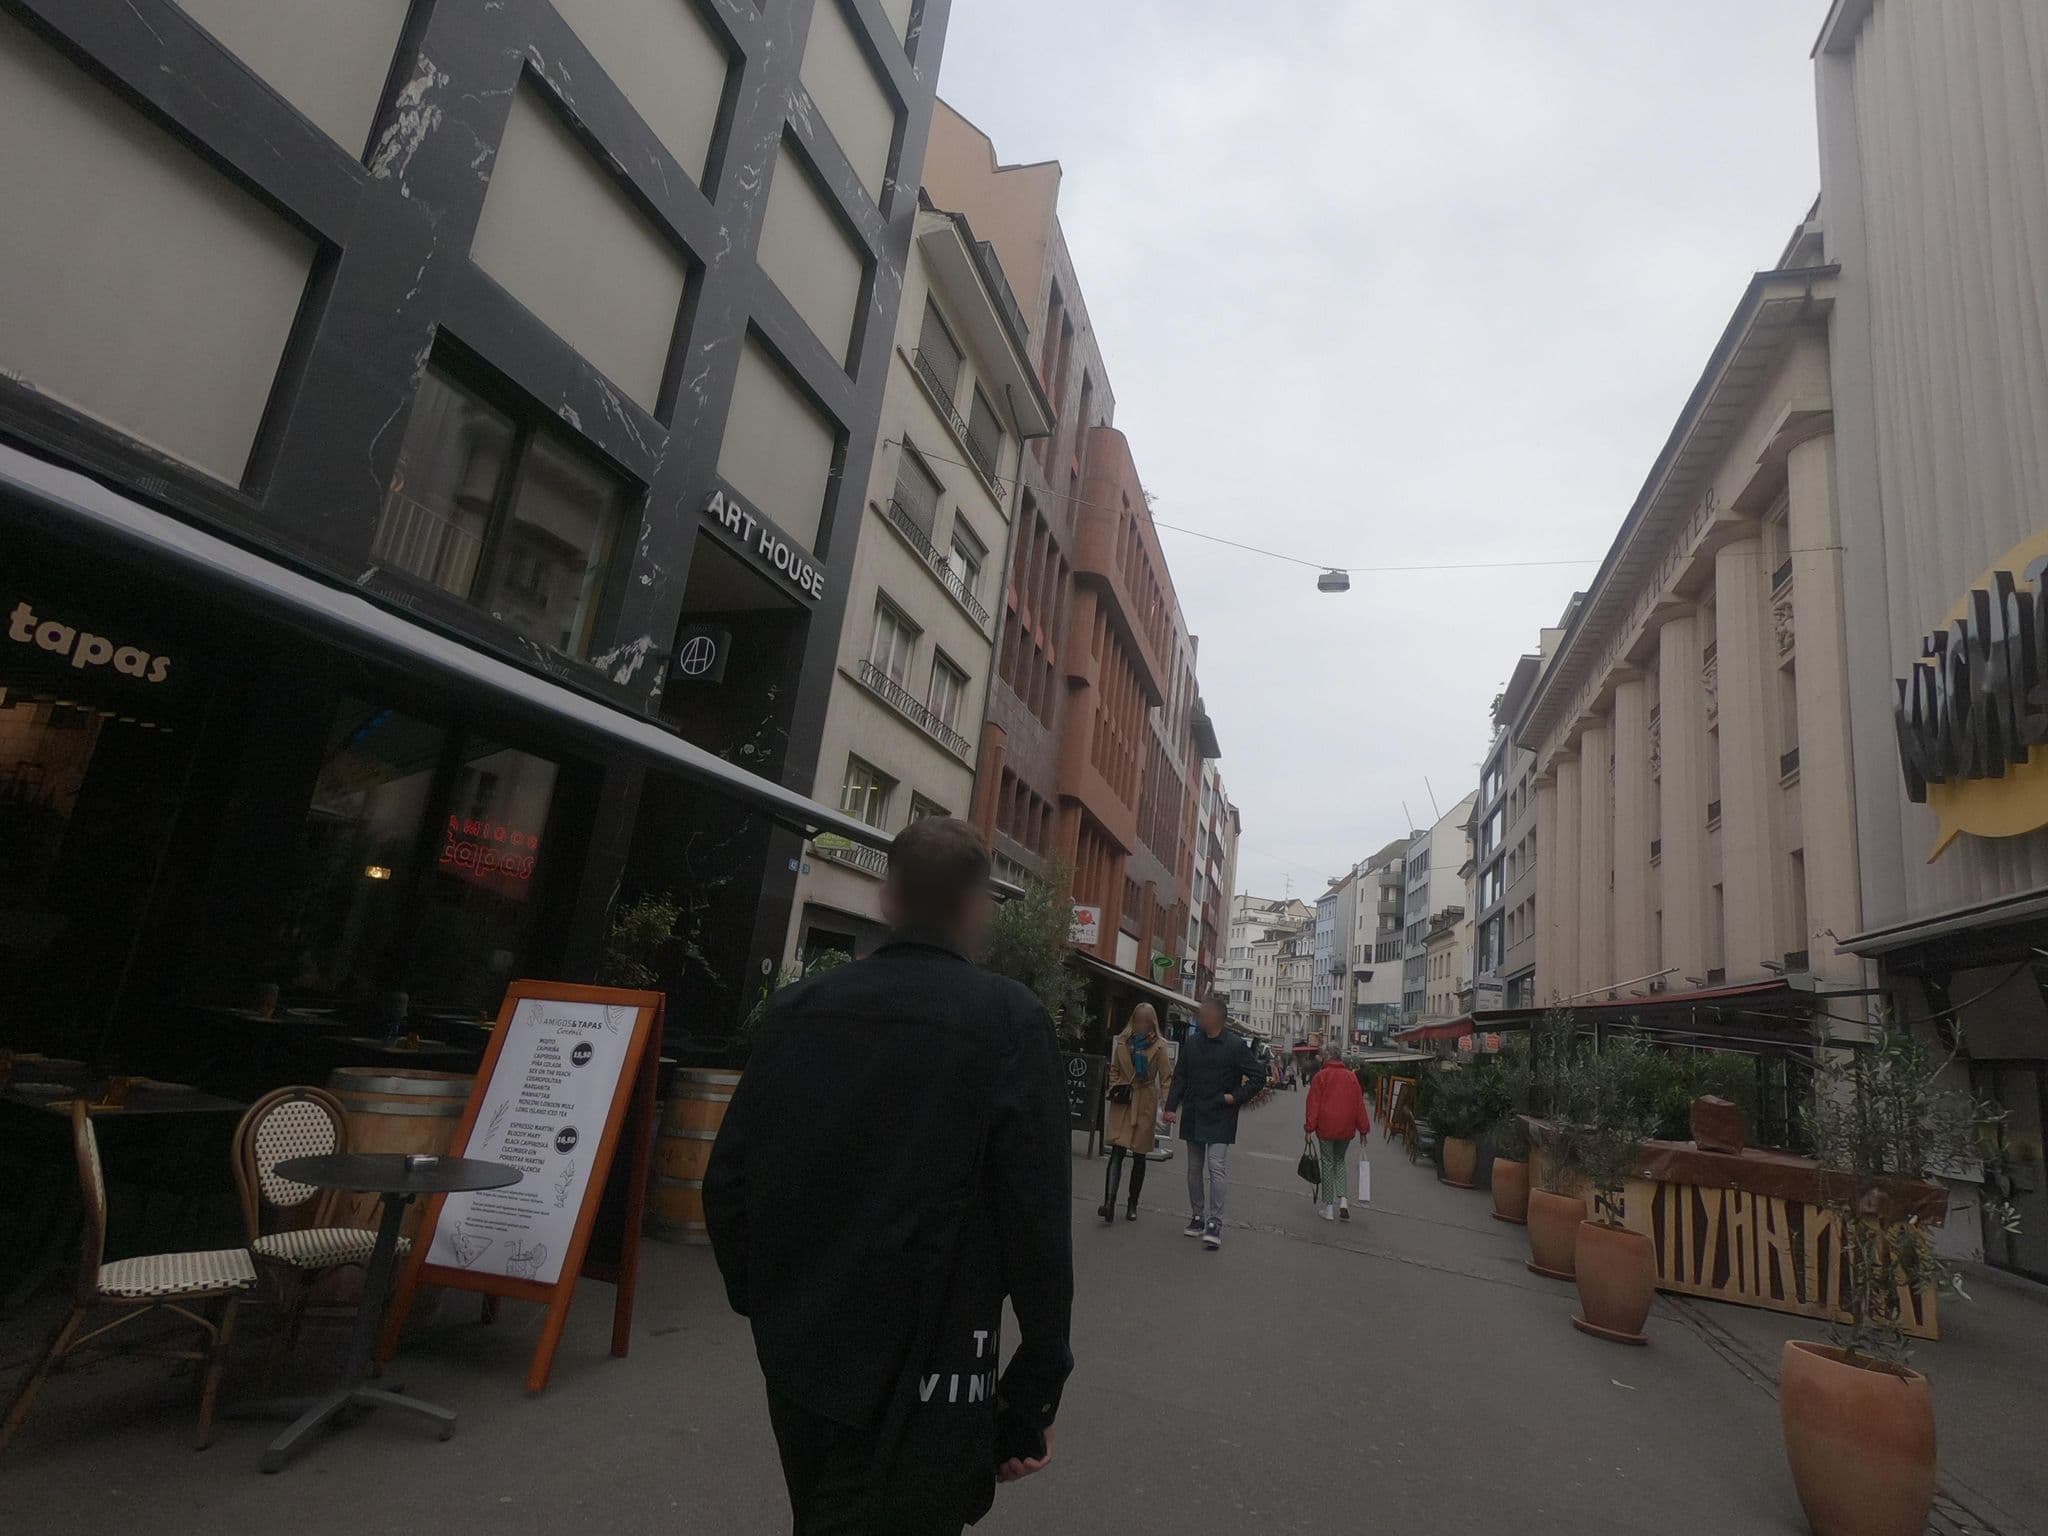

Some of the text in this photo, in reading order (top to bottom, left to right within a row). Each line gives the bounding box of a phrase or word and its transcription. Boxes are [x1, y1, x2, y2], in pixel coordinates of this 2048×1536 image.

[708, 490, 825, 600] ART HOUSE
[8, 601, 172, 683] tapas
